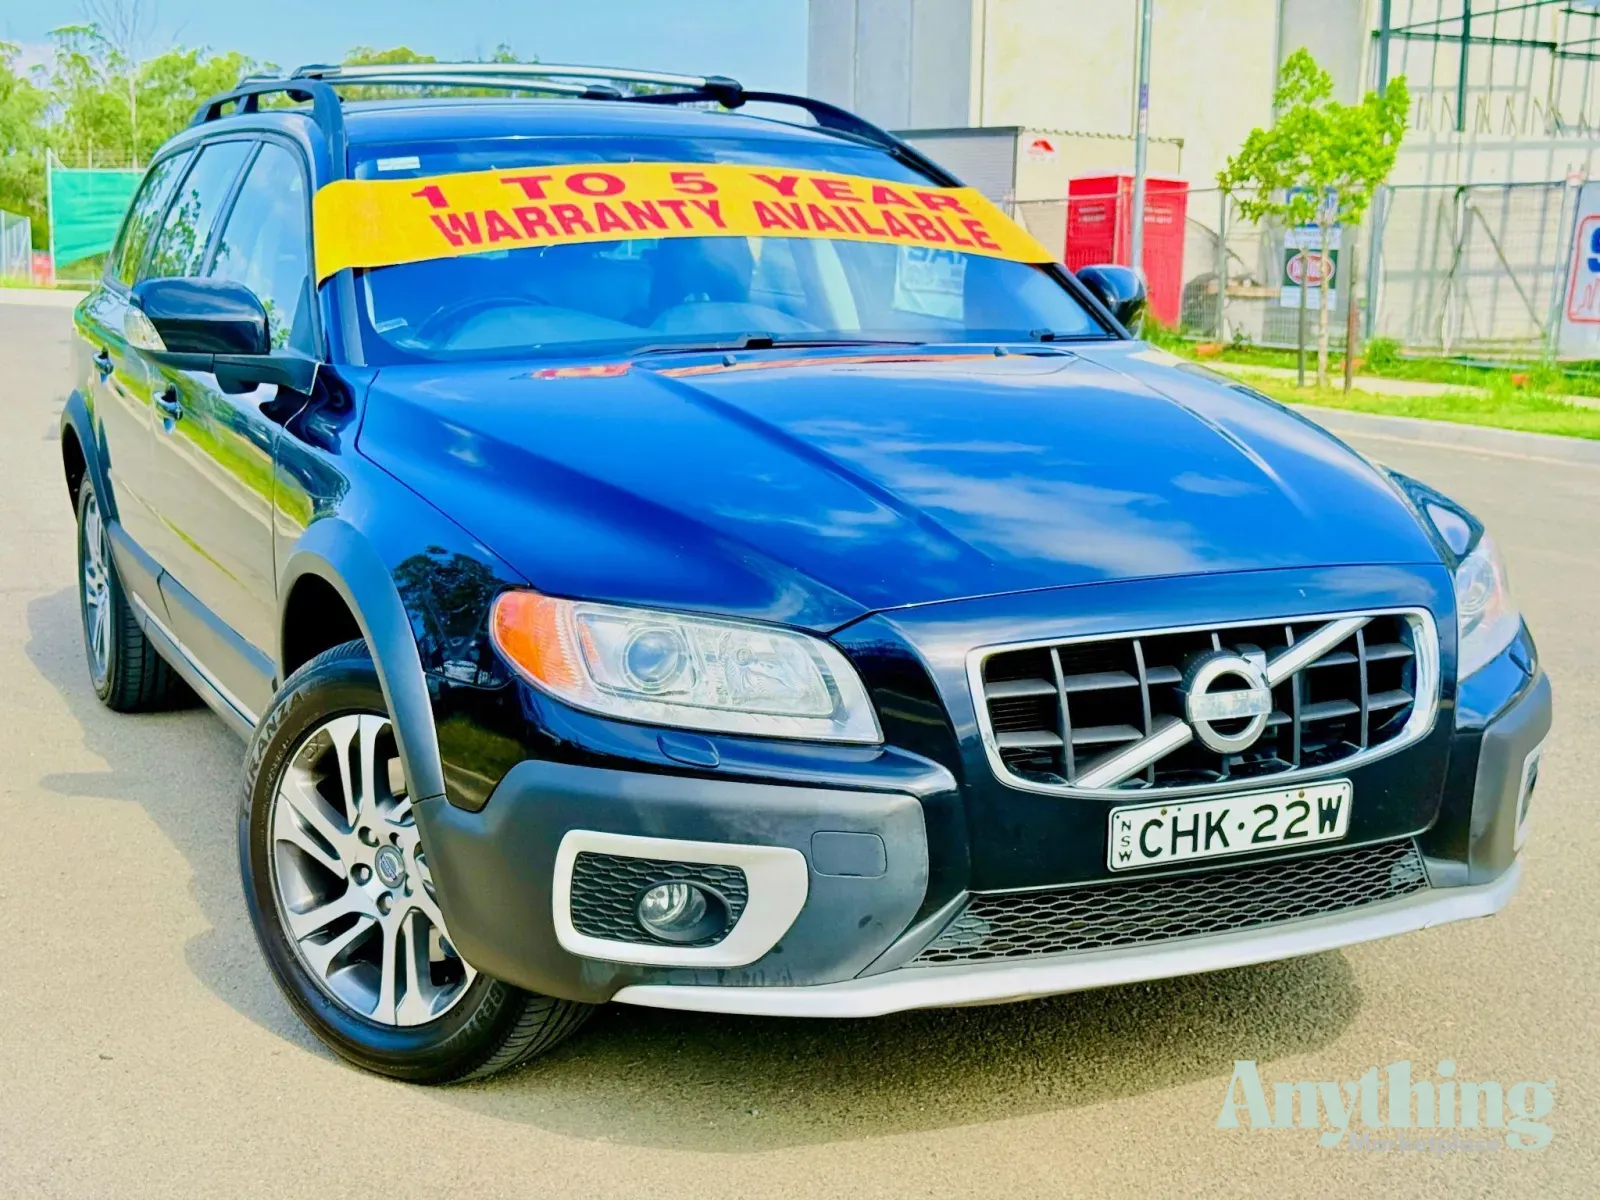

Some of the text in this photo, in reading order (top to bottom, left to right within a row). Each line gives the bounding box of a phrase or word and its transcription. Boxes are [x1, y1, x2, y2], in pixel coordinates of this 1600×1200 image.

[411, 171, 971, 215] 1 TO 5 YEAR
[429, 199, 1003, 251] WARRANTY AVAILABLE
